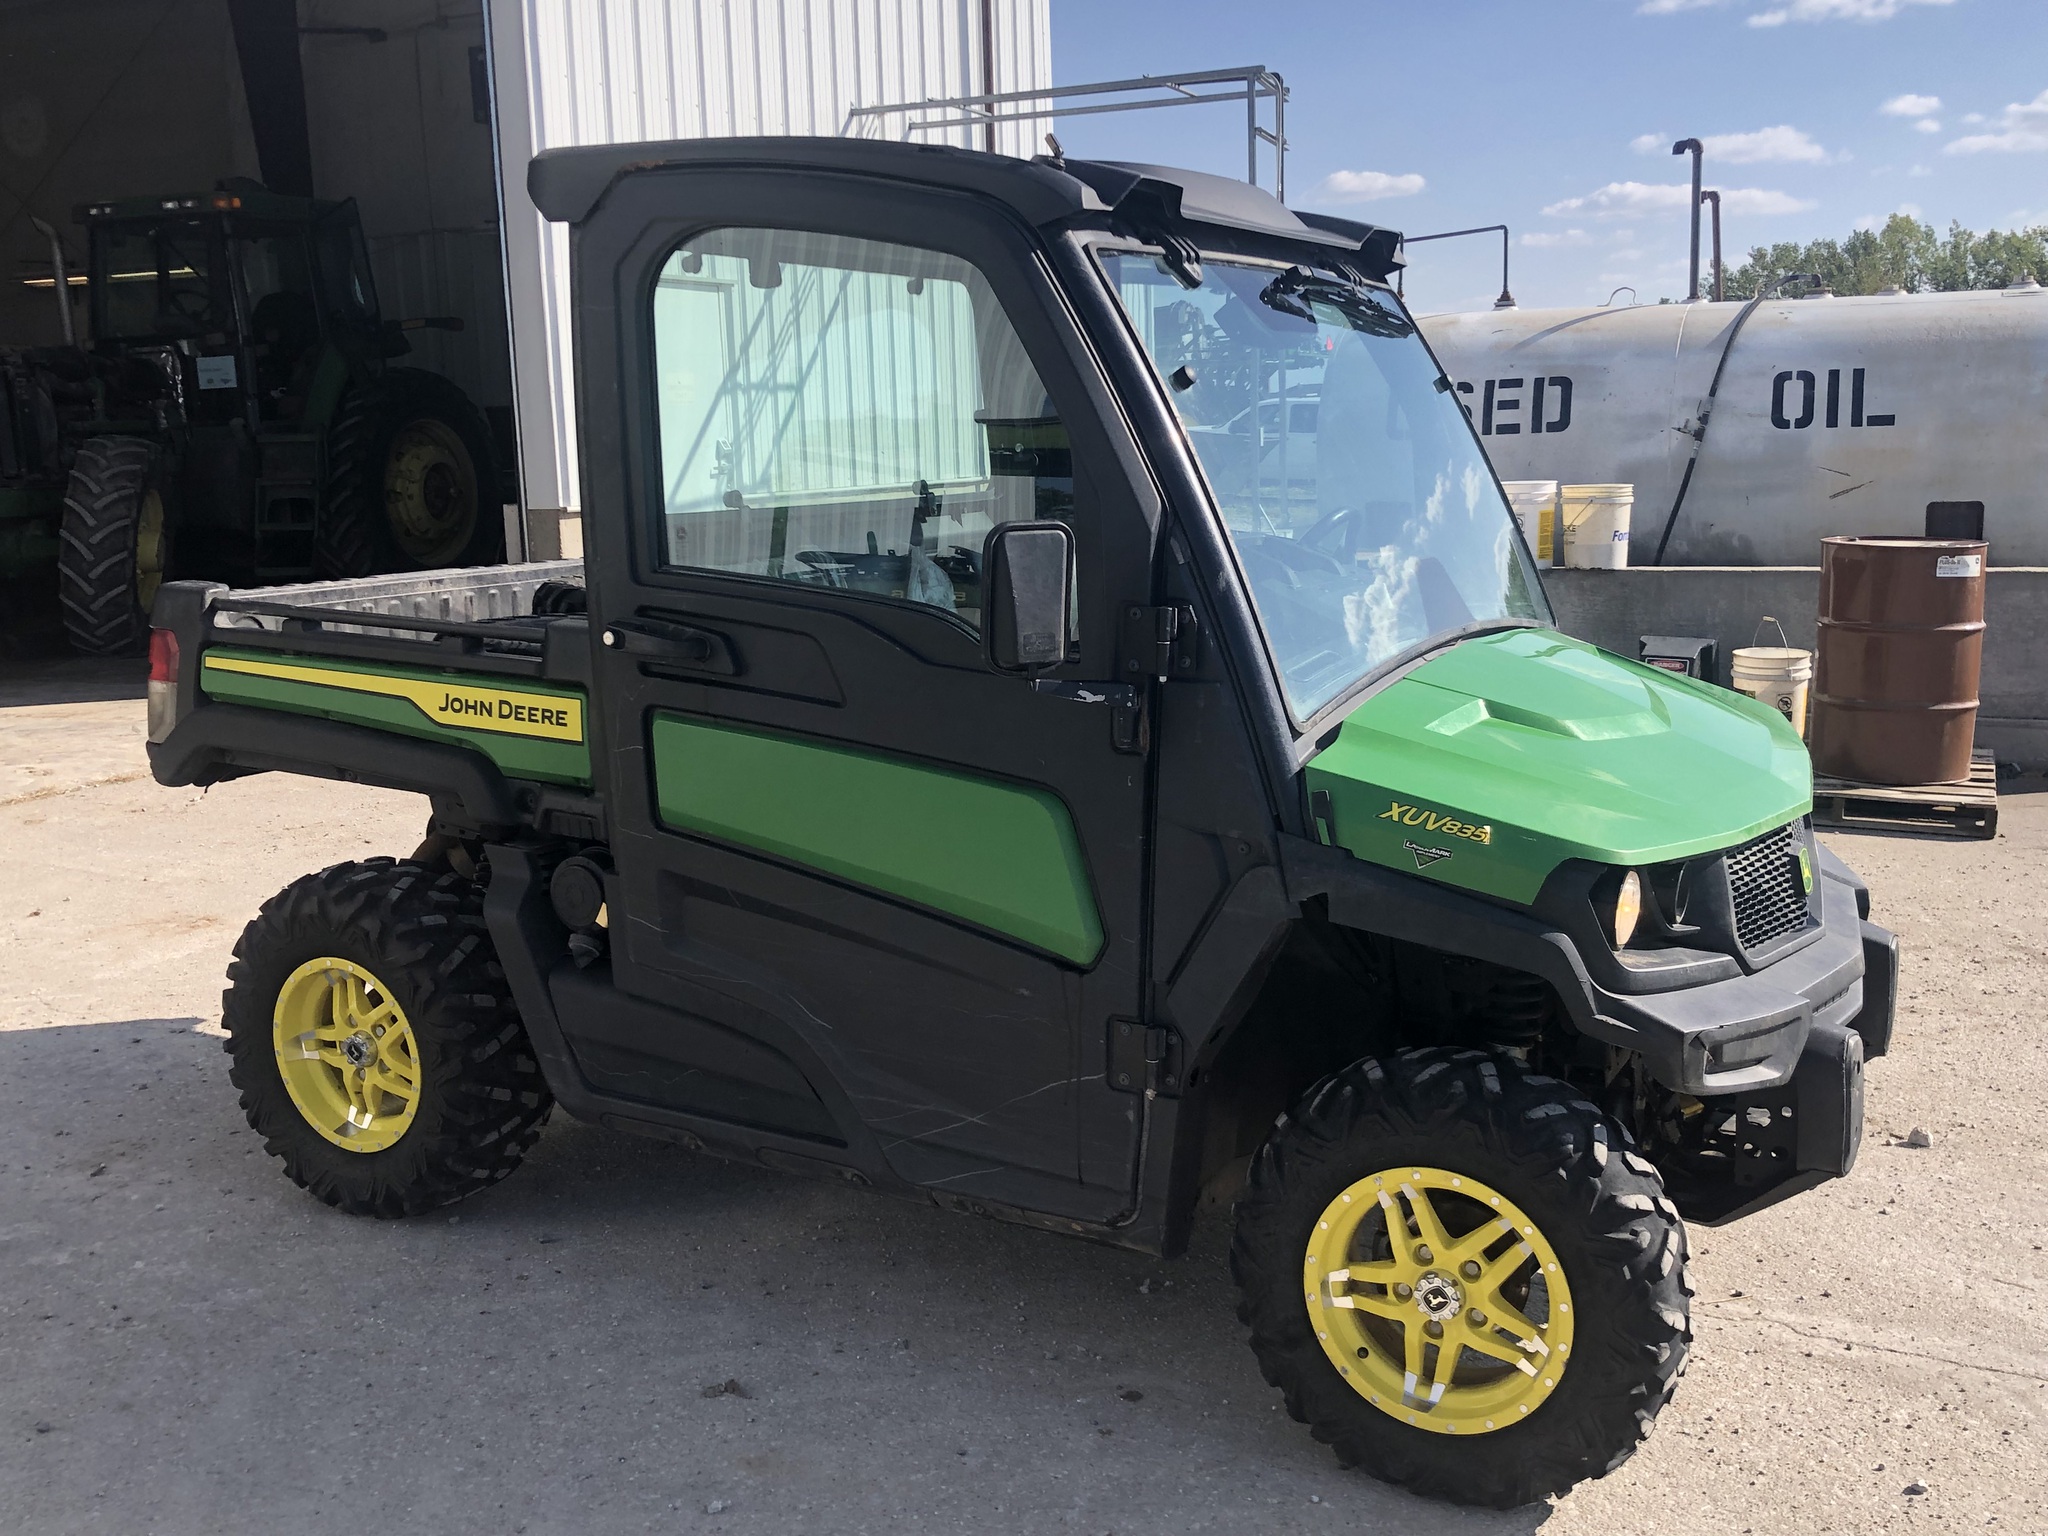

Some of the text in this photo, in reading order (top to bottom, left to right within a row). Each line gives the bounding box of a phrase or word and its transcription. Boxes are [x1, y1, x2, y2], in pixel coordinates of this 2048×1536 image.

[1457, 368, 1896, 436] SED OIL
[438, 693, 568, 727] JOHN DEERE
